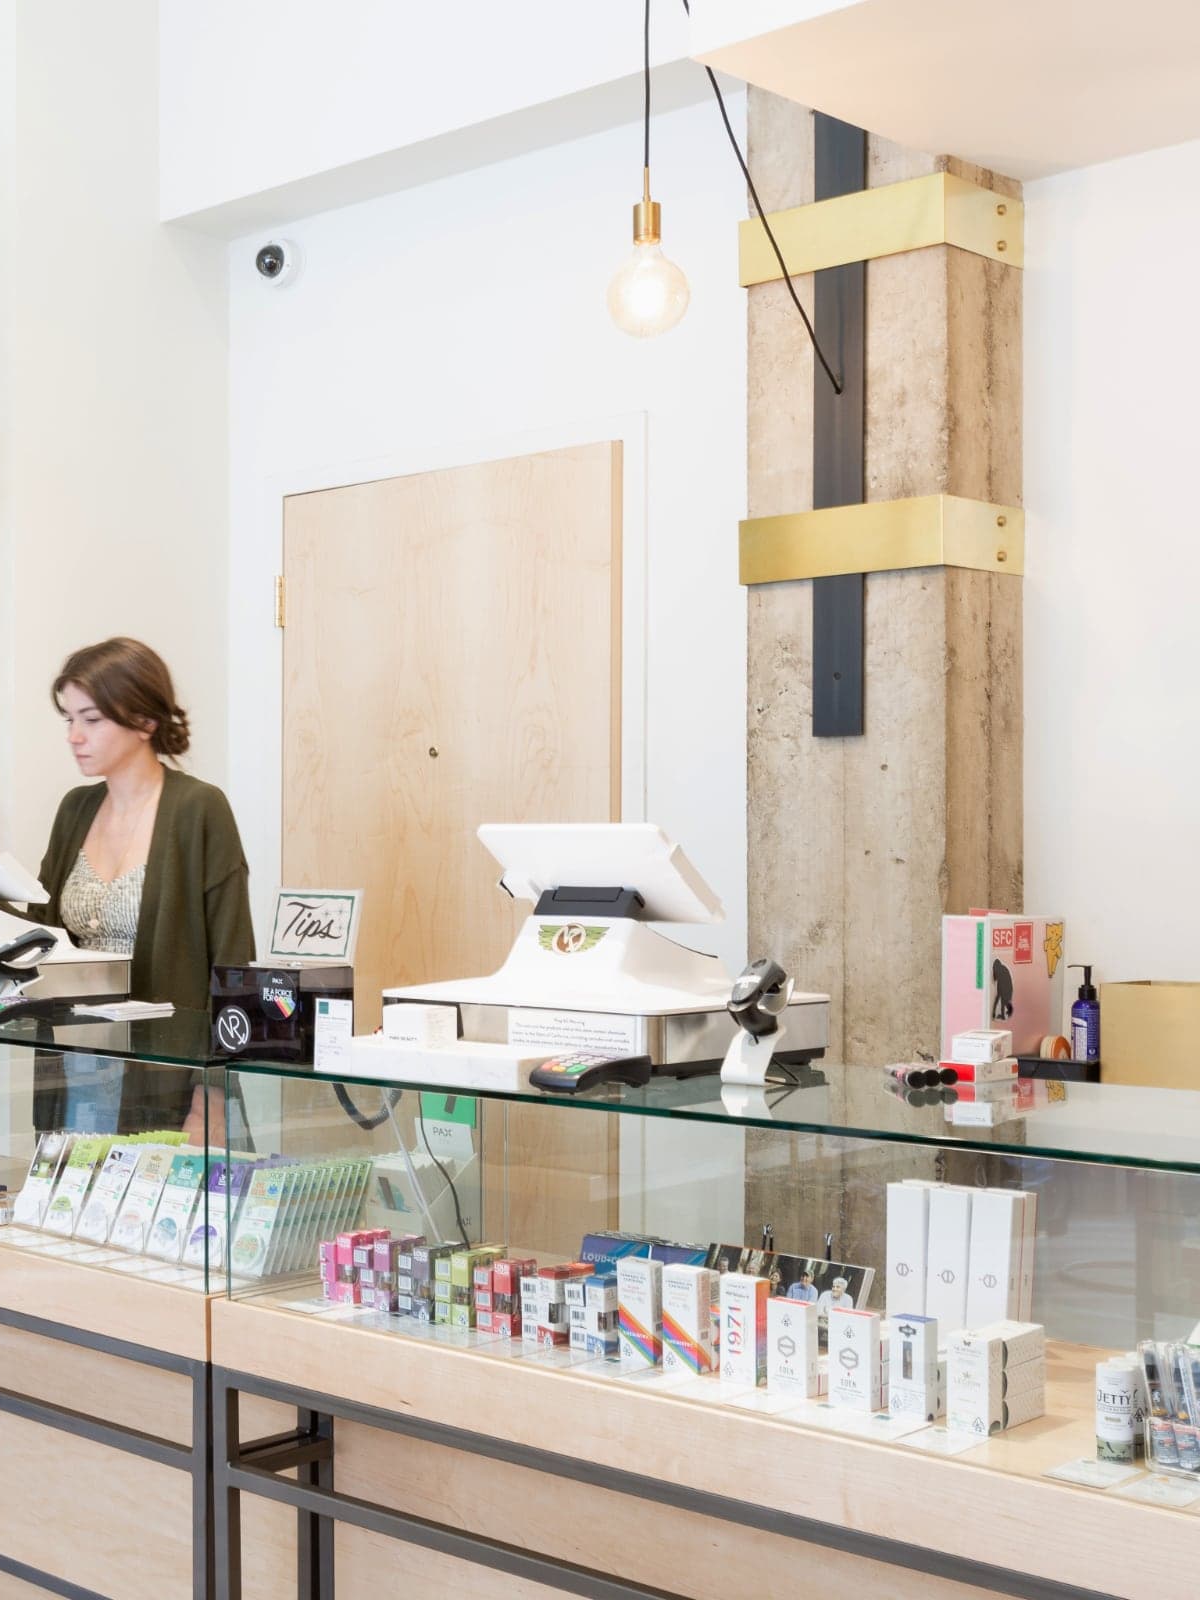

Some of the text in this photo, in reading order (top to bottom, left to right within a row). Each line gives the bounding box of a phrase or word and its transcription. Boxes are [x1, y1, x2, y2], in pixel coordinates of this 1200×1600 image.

[282, 902, 342, 948] Tips
[994, 930, 1012, 945] SFC
[275, 989, 293, 997] FORCE
[433, 1126, 453, 1137] PAX
[727, 1306, 743, 1356] 1971
[779, 1366, 795, 1376] EDEN
[841, 1379, 857, 1389] EDEN
[1097, 1390, 1132, 1405] JETTY
